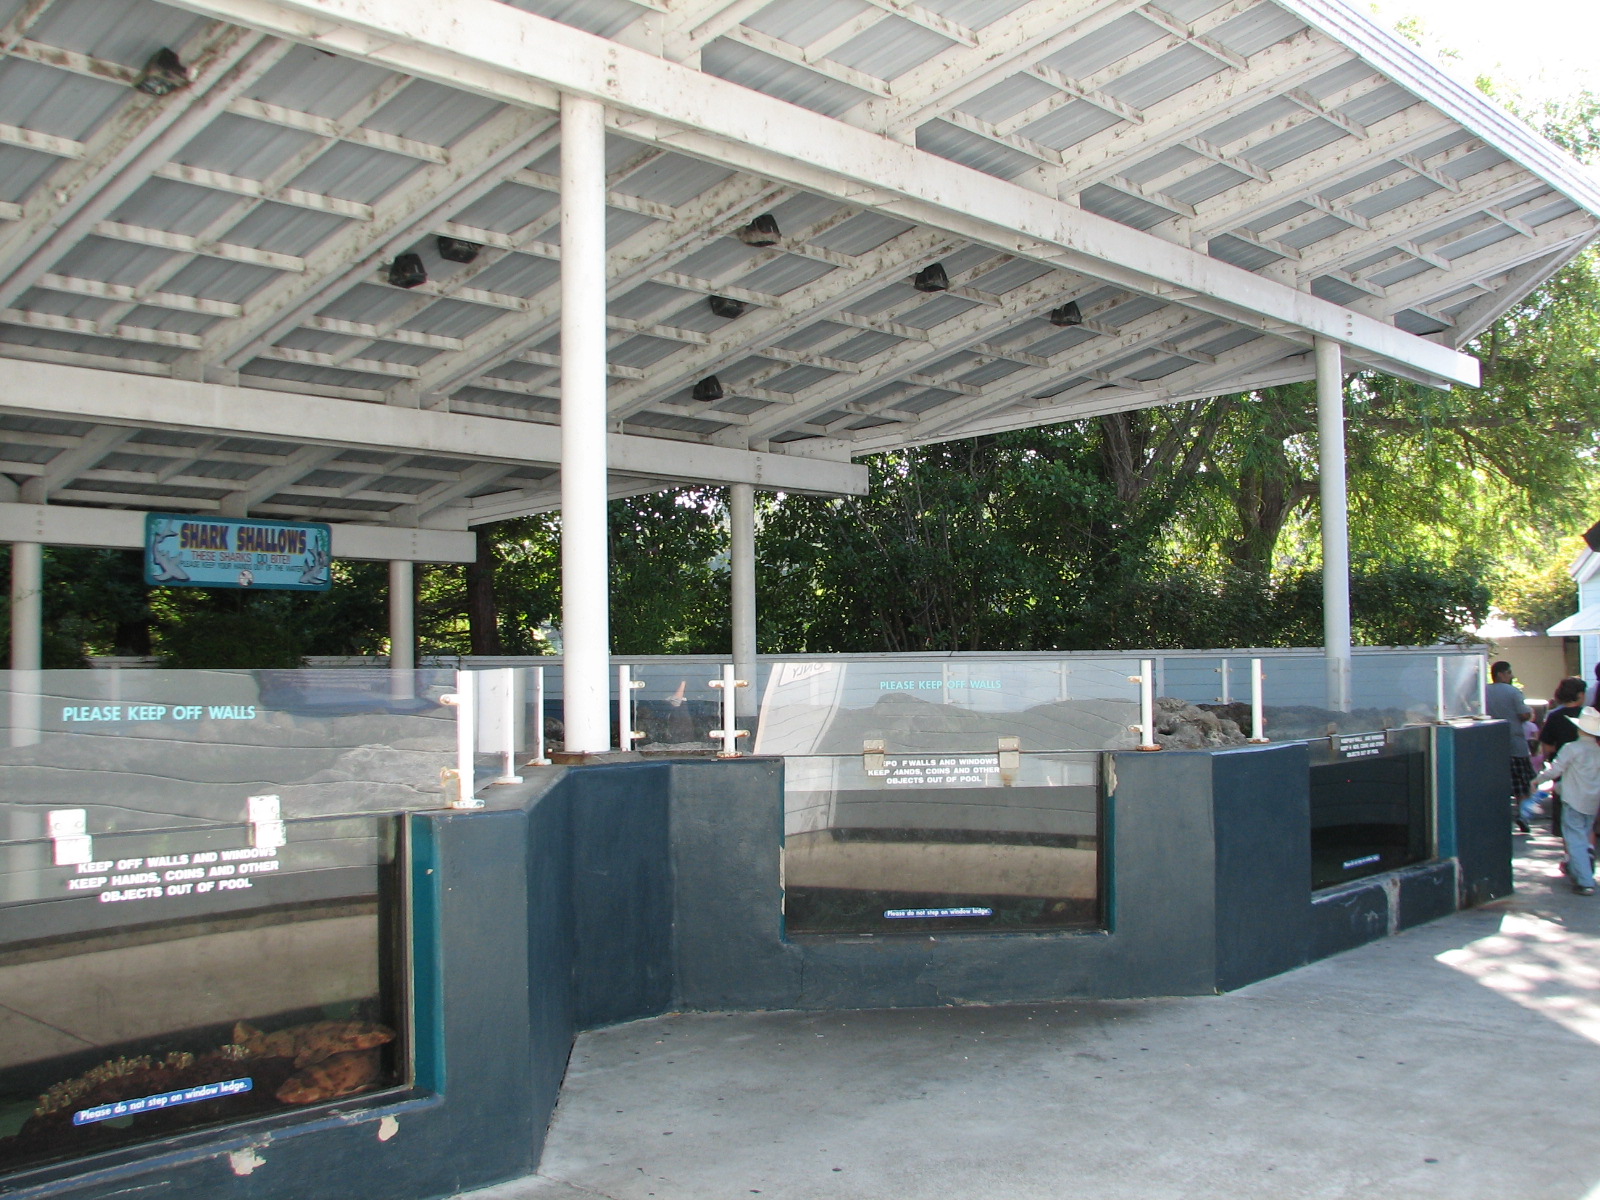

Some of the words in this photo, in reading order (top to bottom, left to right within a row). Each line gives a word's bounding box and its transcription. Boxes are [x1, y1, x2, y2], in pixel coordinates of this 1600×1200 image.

[180, 522, 229, 550] SHARK
[237, 526, 307, 554] SHALLOWS
[191, 551, 216, 561] THESE
[220, 552, 252, 562] SHARKS
[257, 554, 268, 565] DO
[880, 681, 914, 690] PLEASE
[918, 680, 942, 689] KEEP
[947, 680, 966, 689] OFF
[970, 680, 1001, 689] WALLS
[63, 706, 121, 721] PLEASE
[128, 706, 166, 721] KEEP
[172, 706, 203, 720] OFF
[208, 706, 256, 720] WALLS
[78, 861, 114, 873] KEEP
[117, 858, 143, 871] OFF
[147, 854, 189, 868] WALLS
[193, 852, 218, 864] AND
[221, 847, 276, 860] WINDOWS
[69, 877, 107, 890] KEEP
[112, 872, 161, 886] HANDS,
[165, 868, 205, 881] COINS
[210, 864, 235, 876] AND
[239, 860, 279, 874] OTHER
[100, 887, 163, 903] OBJECTS
[167, 884, 193, 896] OUT
[197, 882, 215, 893] OF
[219, 878, 252, 890] POOL
[80, 1108, 111, 1121] Please
[114, 1103, 127, 1113] do
[130, 1101, 144, 1110] not
[148, 1096, 167, 1108] step
[186, 1087, 218, 1099] window
[222, 1080, 247, 1094] ledge.
